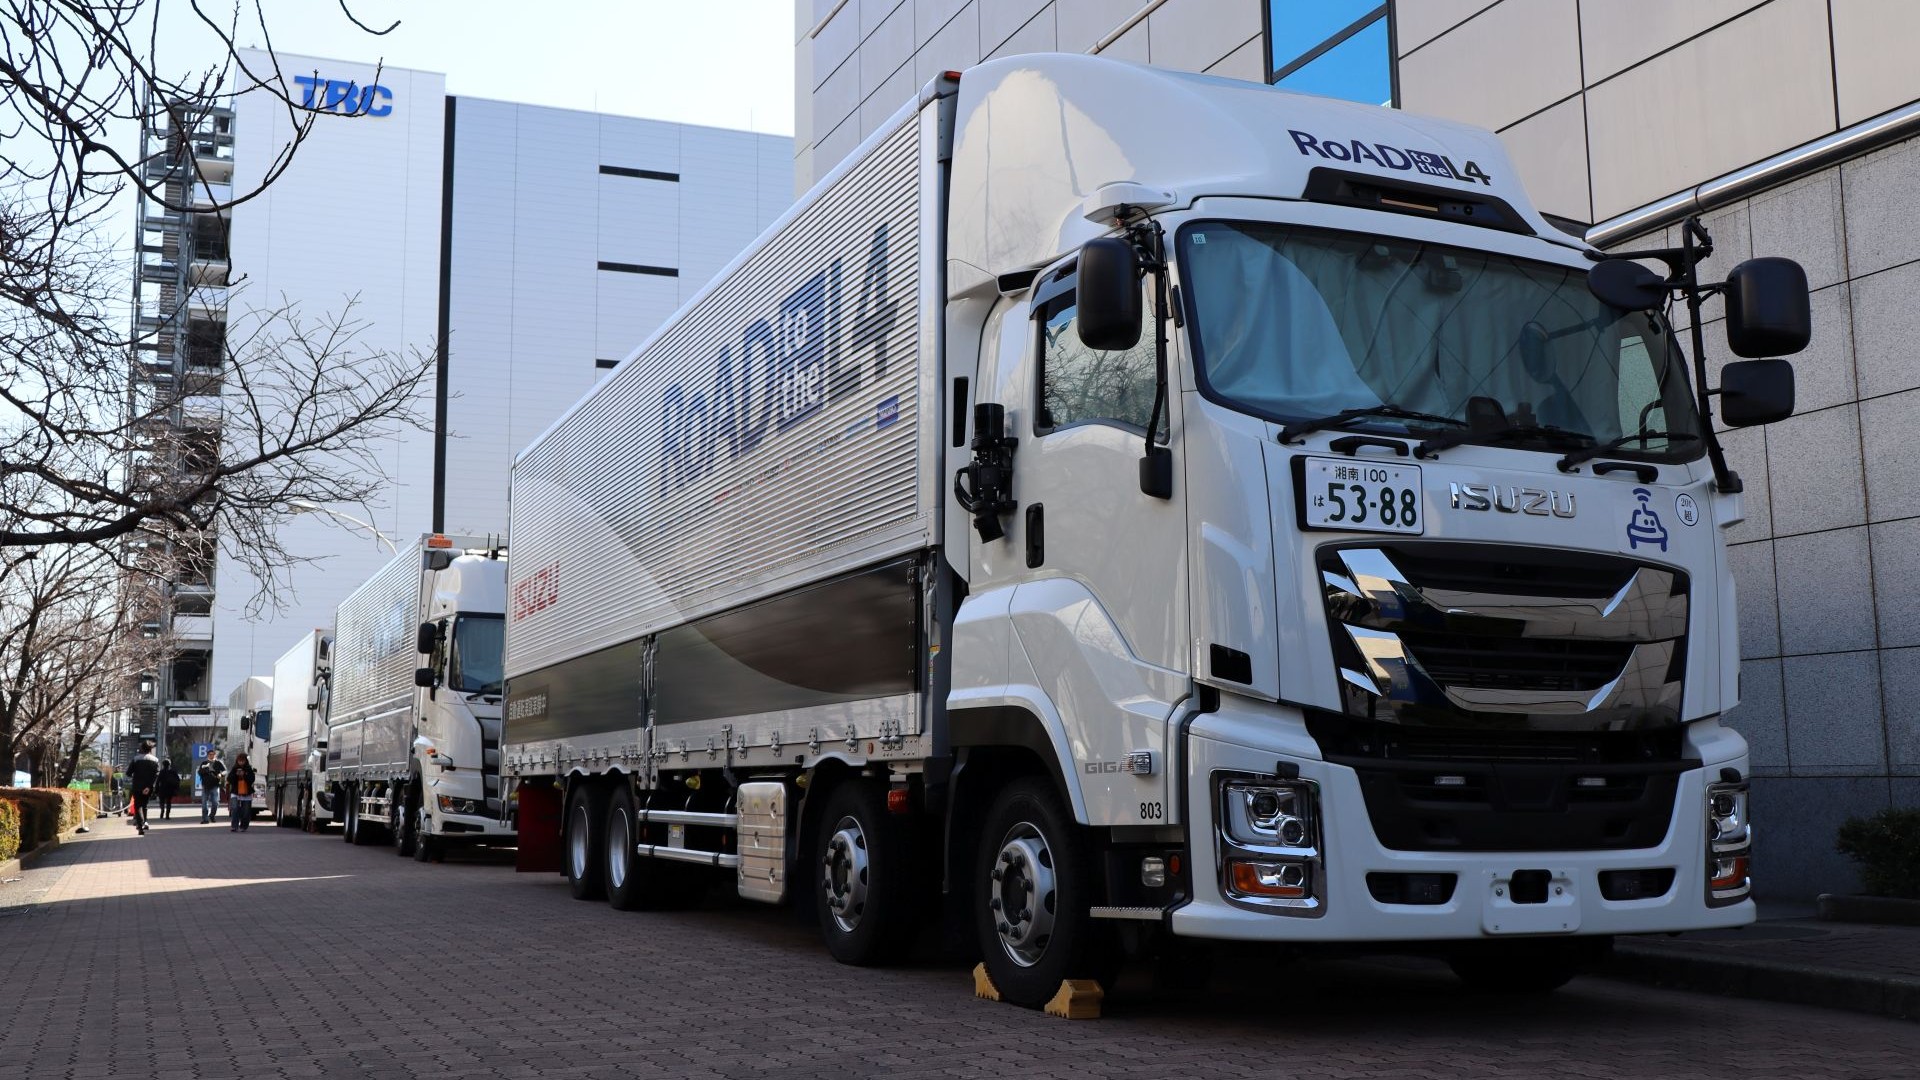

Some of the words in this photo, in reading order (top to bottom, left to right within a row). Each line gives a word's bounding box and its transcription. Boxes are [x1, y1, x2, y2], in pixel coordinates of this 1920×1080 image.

[294, 76, 392, 117] TRC
[1288, 129, 1413, 171] RoAD
[1411, 151, 1432, 164] to
[1418, 162, 1448, 176] the
[1441, 155, 1491, 186] L4
[827, 221, 900, 404] L4
[1334, 466, 1359, 481] 湘南
[1363, 468, 1388, 483] 100
[1328, 482, 1417, 527] 53-88
[1450, 481, 1577, 519] ISUZU
[512, 560, 560, 623] ISUZU
[198, 745, 207, 758] B
[1140, 802, 1162, 820] 803
